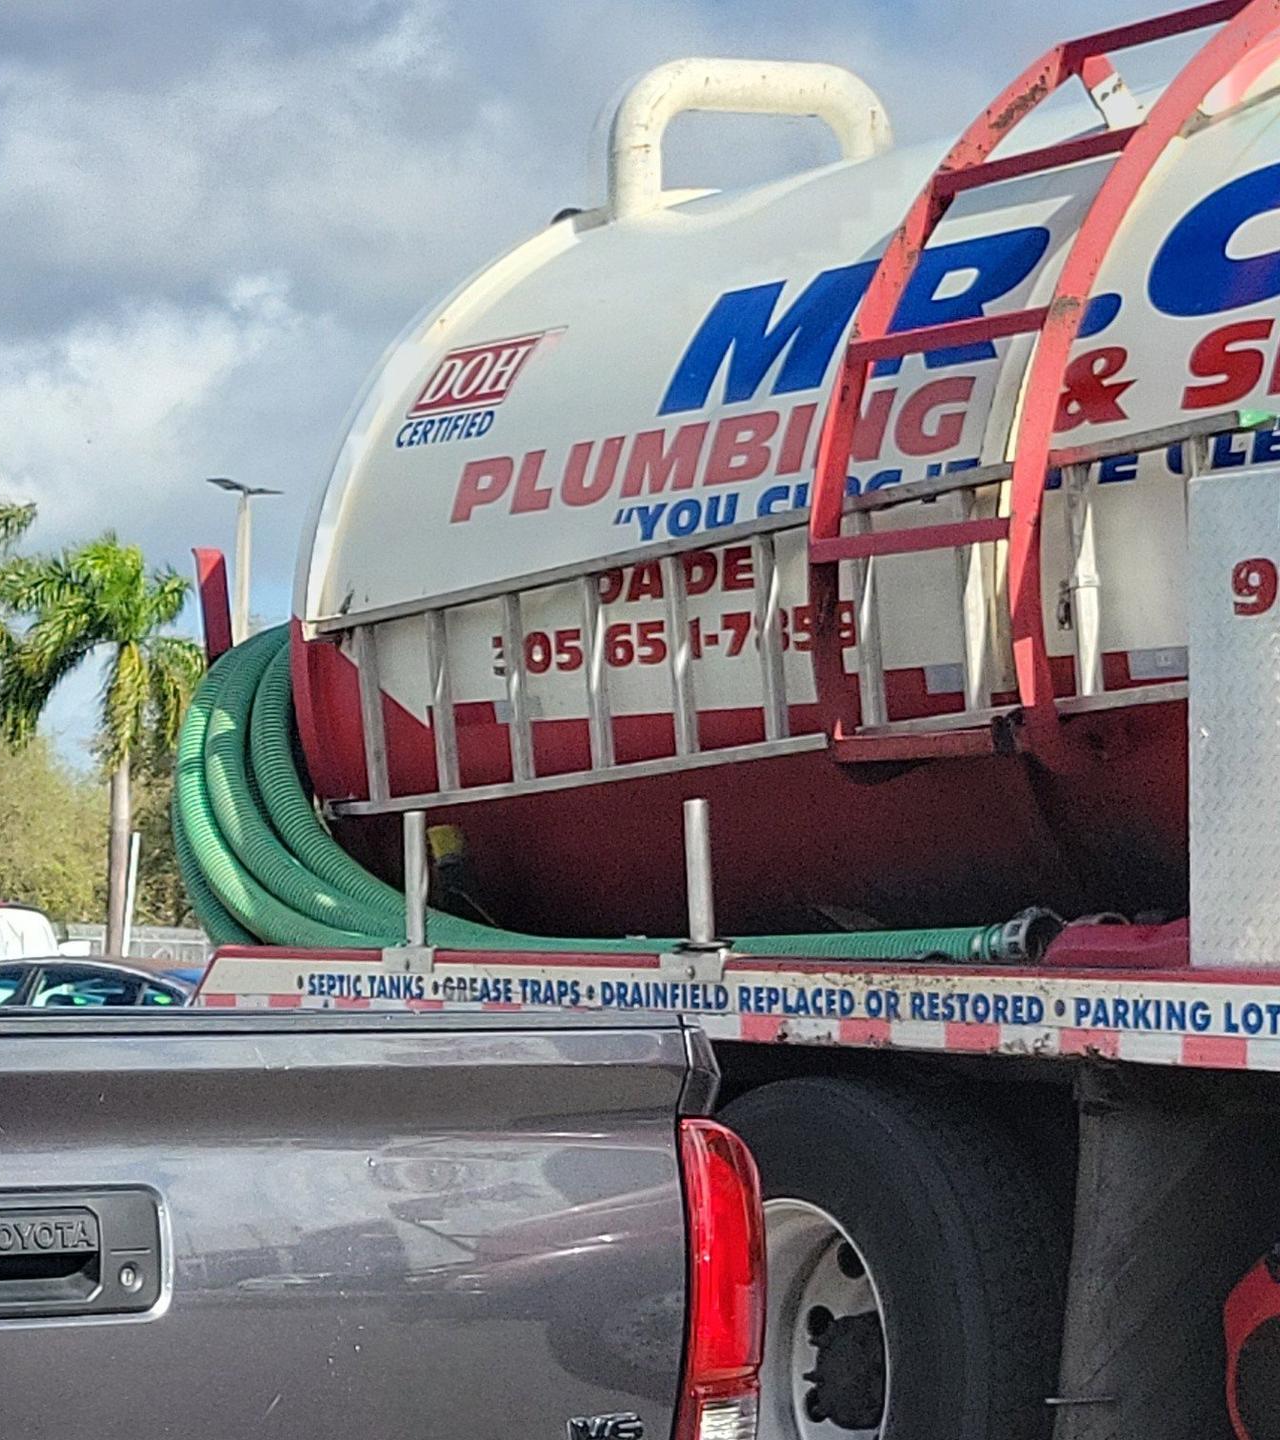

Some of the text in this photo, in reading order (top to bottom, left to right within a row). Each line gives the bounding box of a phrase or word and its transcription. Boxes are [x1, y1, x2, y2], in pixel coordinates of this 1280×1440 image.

[418, 346, 532, 404] DOH
[396, 410, 495, 448] CERTIFIED
[450, 375, 976, 524] PLUMBING
[1052, 346, 1138, 433] &
[1180, 318, 1280, 410] S
[492, 628, 583, 677] 05
[307, 973, 363, 997] SEPTIC
[368, 975, 426, 999] TANKS
[442, 976, 513, 1004] GREASE
[518, 978, 581, 1006] TRAPS
[600, 981, 730, 1011] DRAINFIELD
[738, 986, 856, 1016] REPLACED
[864, 988, 900, 1018] OR
[910, 991, 1045, 1024] RESTORED
[1073, 997, 1212, 1032] PARKING
